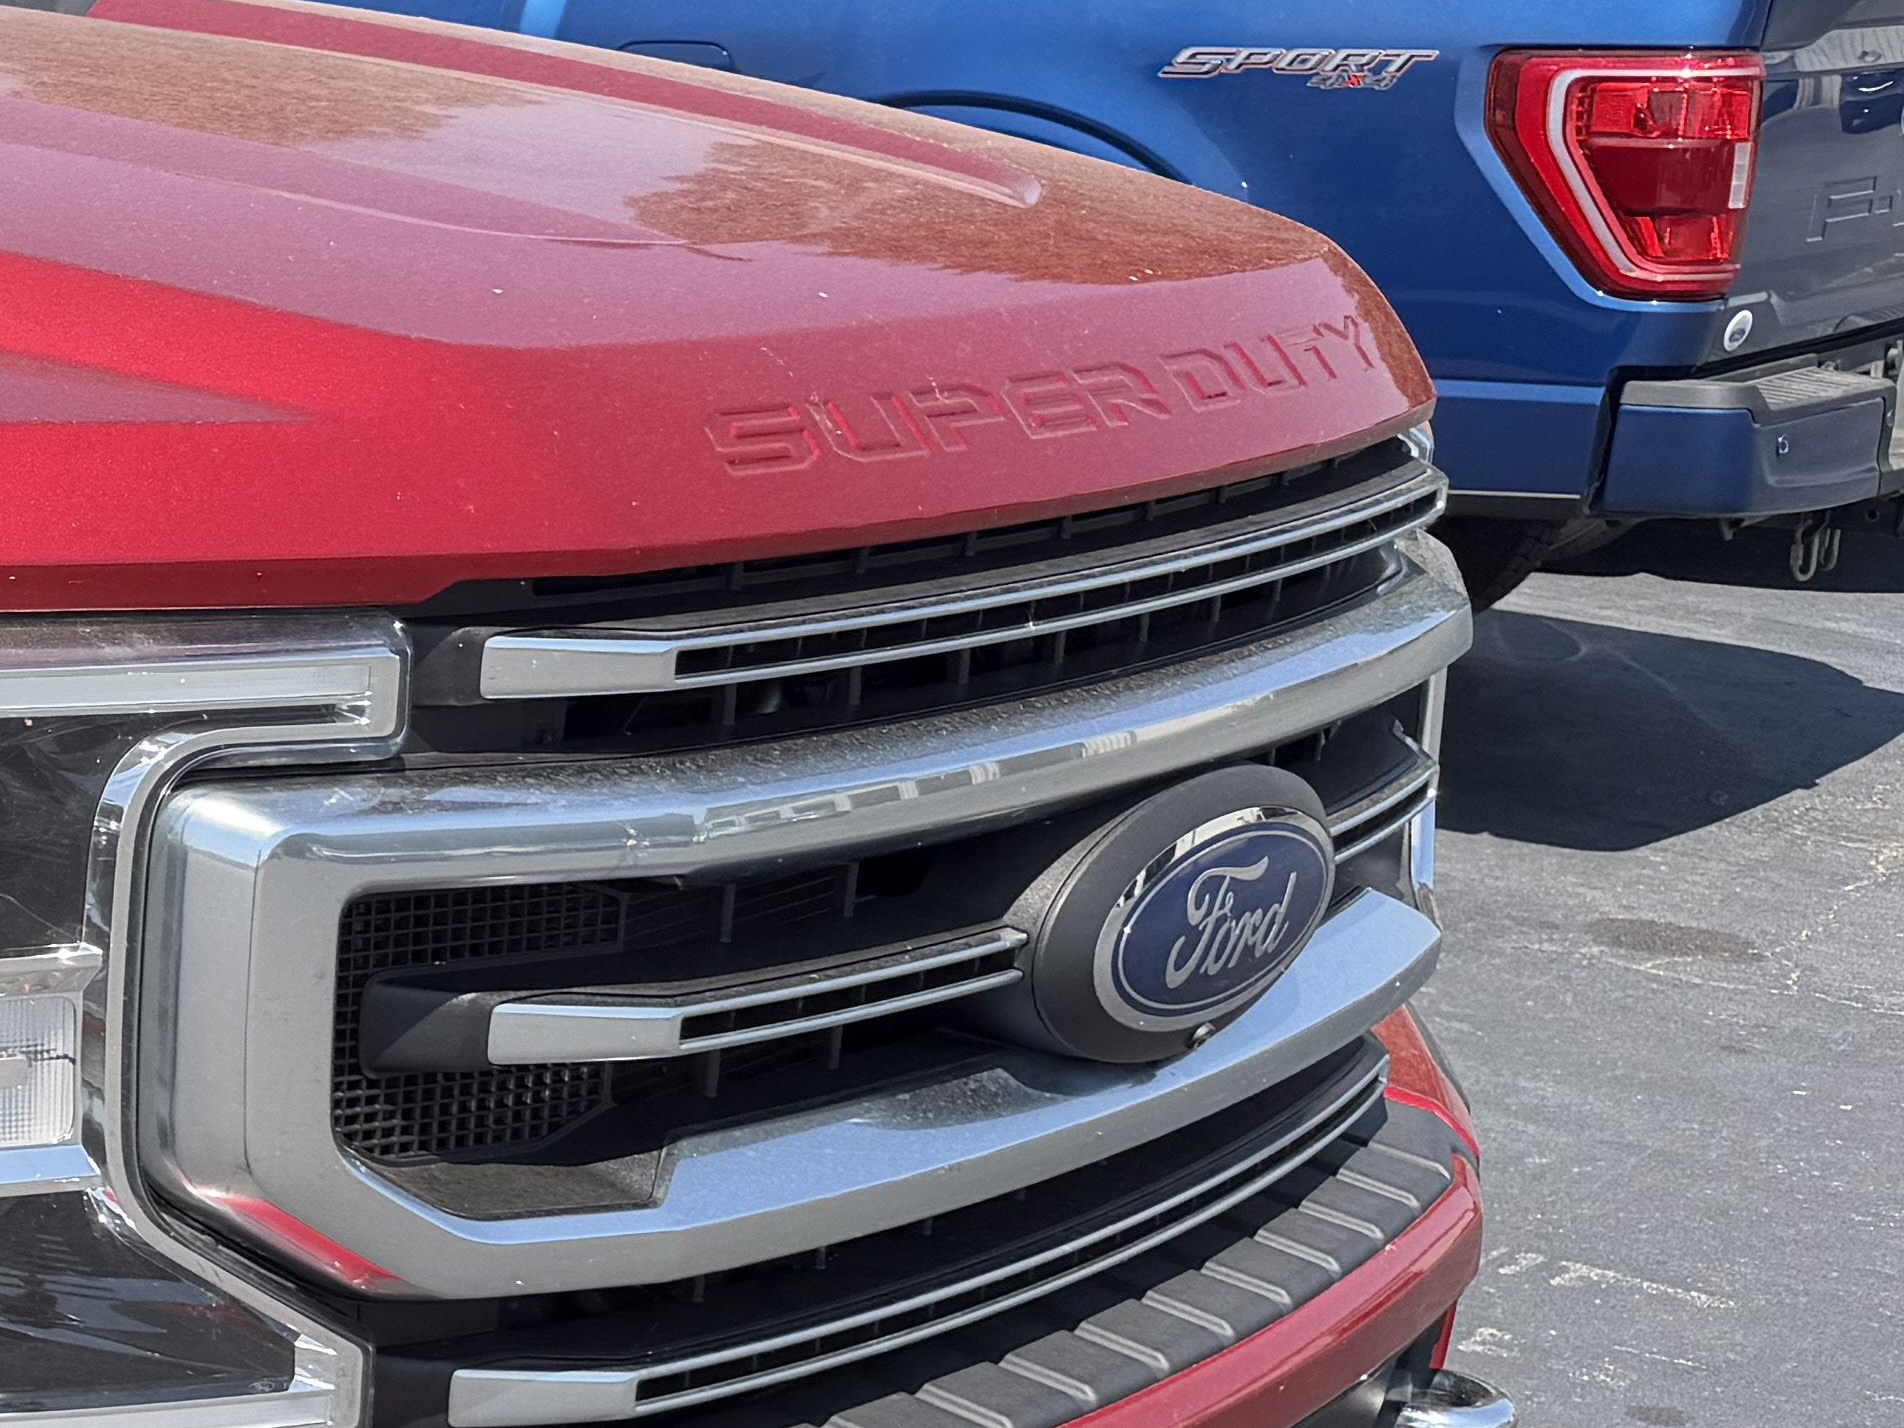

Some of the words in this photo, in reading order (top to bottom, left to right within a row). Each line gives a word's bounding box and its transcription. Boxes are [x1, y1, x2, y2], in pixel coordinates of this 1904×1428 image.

[1157, 46, 1441, 79] SPORT
[703, 361, 1173, 476] SUPER
[1161, 315, 1380, 414] DUTY
[1165, 856, 1298, 989] Ford
